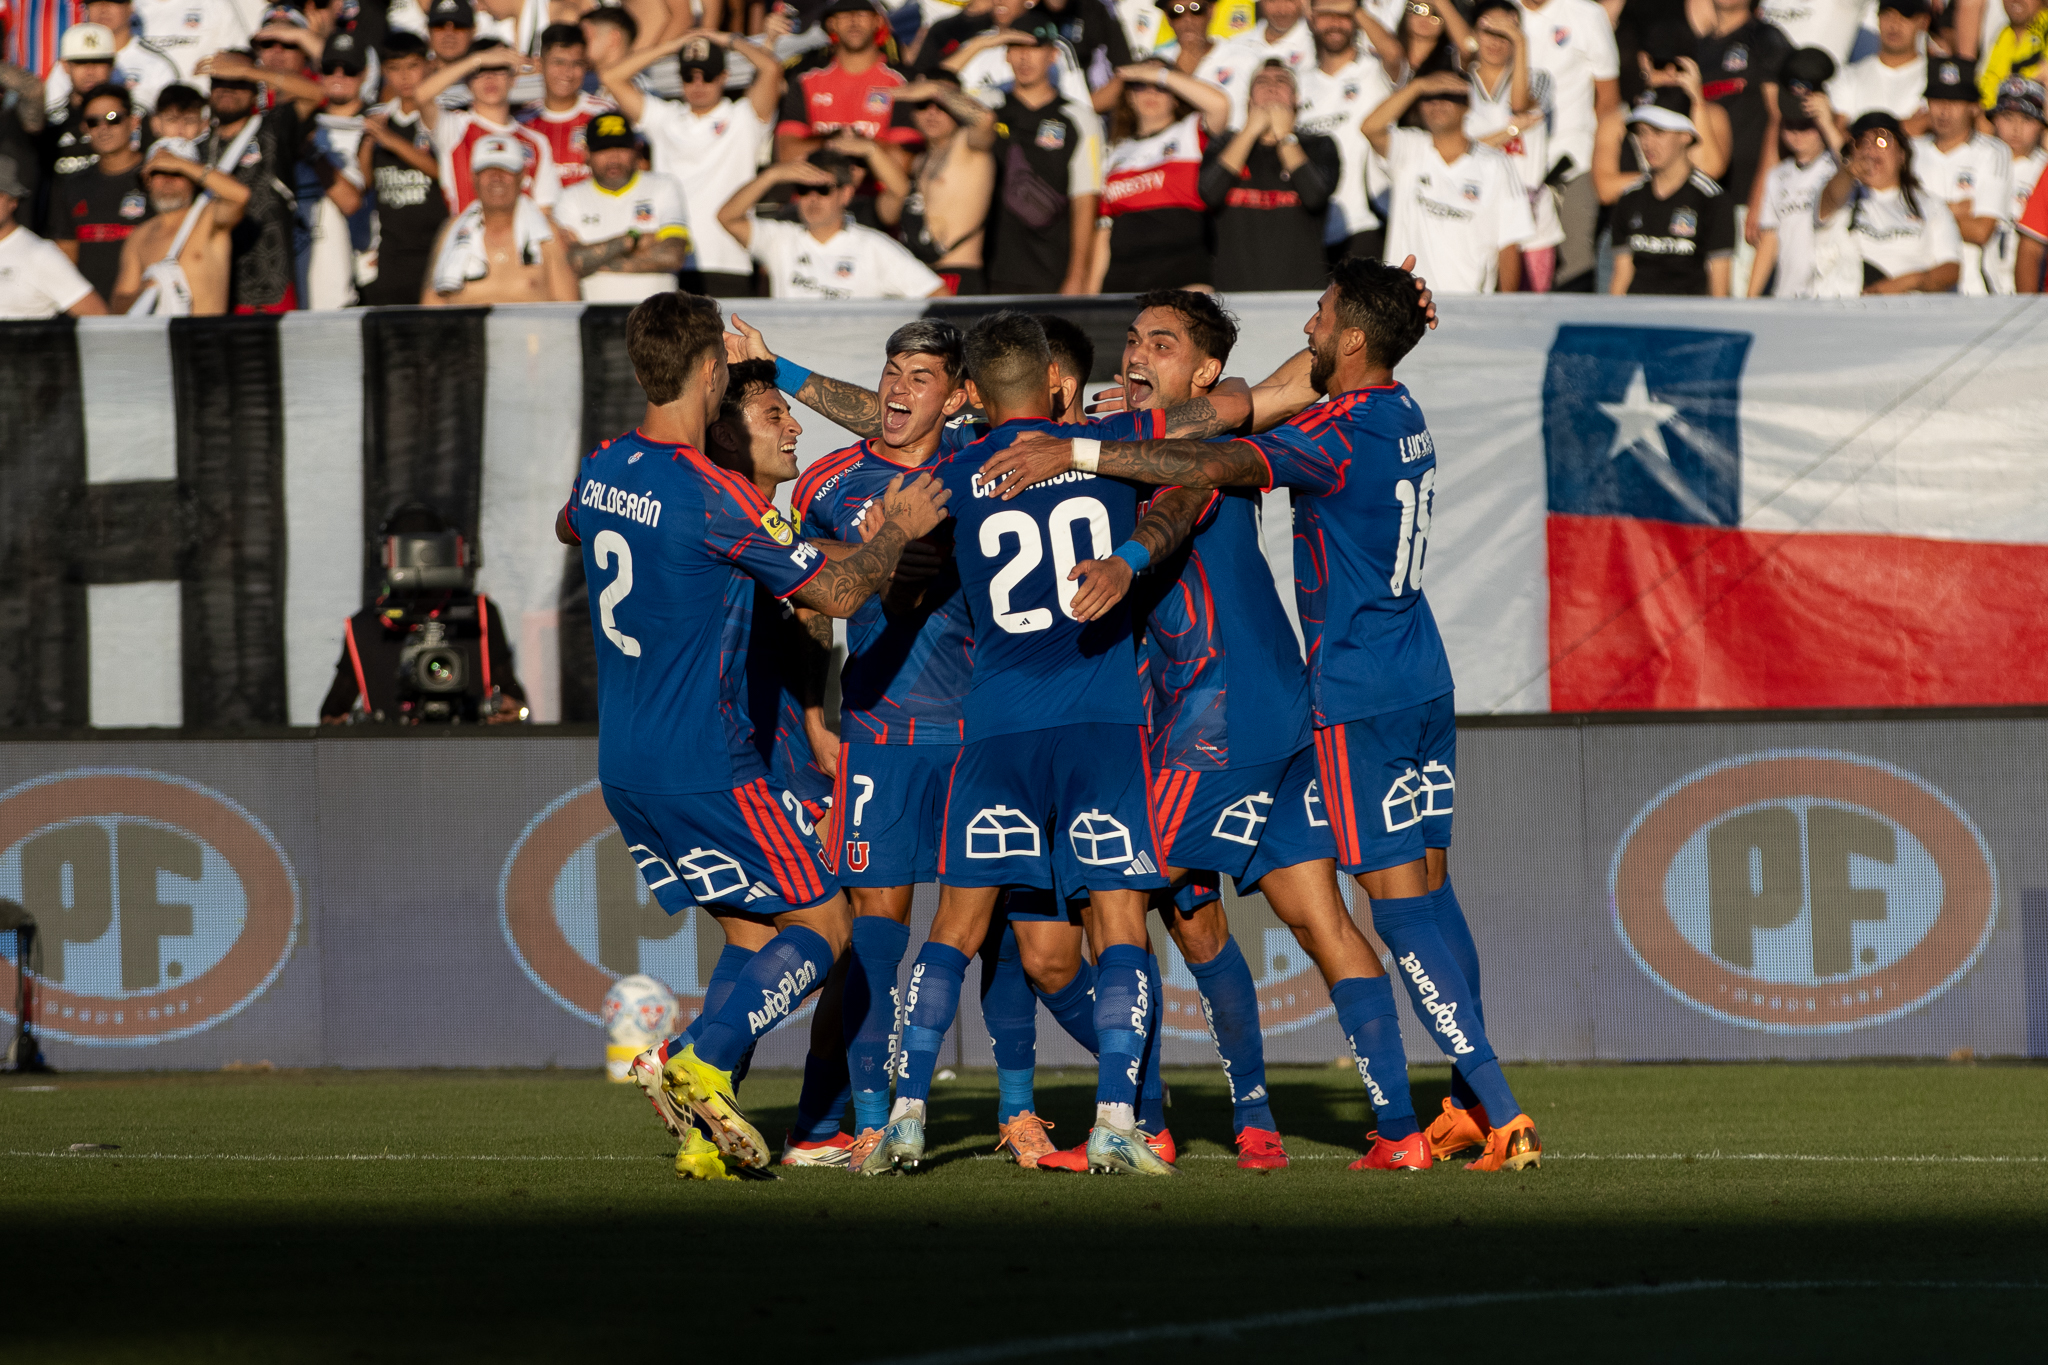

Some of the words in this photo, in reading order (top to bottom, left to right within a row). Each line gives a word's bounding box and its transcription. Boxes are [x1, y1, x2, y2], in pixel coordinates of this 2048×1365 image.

[581, 479, 662, 528] CALDERÓN
[979, 496, 1113, 634] 20
[594, 530, 641, 657] 2
[782, 789, 814, 836] 2
[853, 774, 874, 826] 7
[847, 841, 870, 872] U
[748, 960, 817, 1035] AutoPlan
